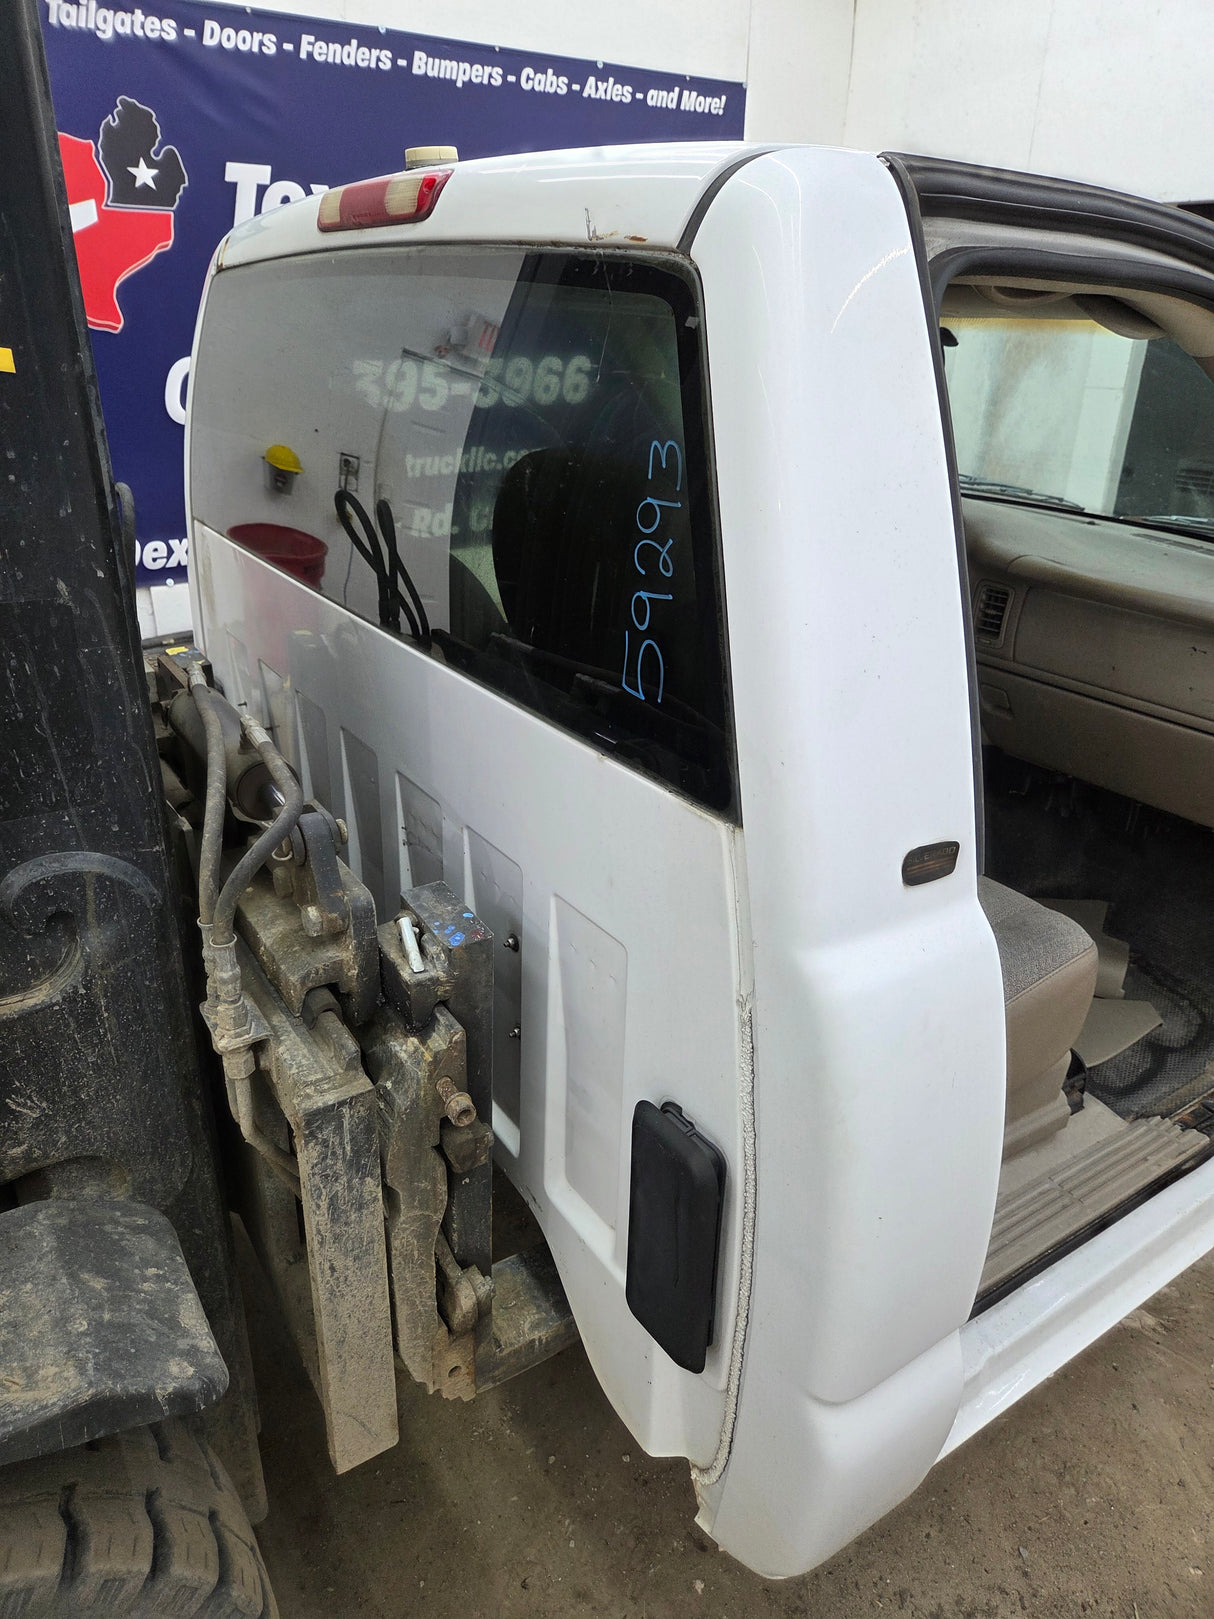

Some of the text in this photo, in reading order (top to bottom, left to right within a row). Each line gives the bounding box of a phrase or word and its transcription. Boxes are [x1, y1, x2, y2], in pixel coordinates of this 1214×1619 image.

[45, 0, 178, 40] Tailgates
[202, 19, 278, 55] Doors
[299, 34, 393, 71] Fenders
[411, 50, 504, 88] Bumpers
[520, 66, 569, 95] Cabs
[582, 75, 633, 104] Axles
[646, 86, 681, 110] and
[679, 89, 727, 116] More!
[621, 440, 682, 703] 59293
